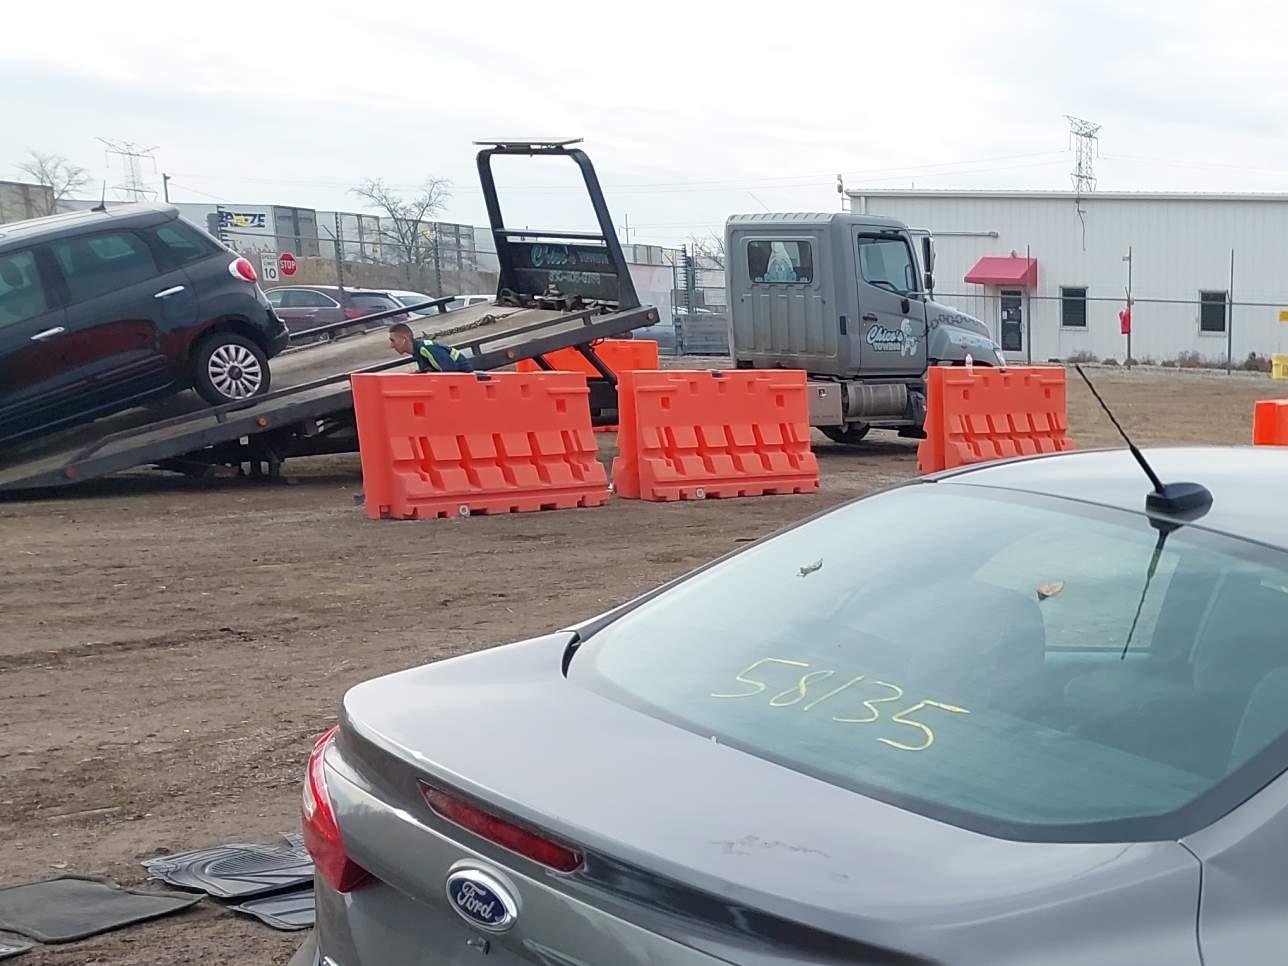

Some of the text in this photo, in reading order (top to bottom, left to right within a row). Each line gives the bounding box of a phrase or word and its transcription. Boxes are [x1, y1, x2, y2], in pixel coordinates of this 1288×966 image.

[264, 267, 276, 279] 10
[280, 260, 296, 270] STOP
[866, 325, 904, 344] Chico's
[710, 657, 971, 751] 58135
[457, 881, 495, 918] Ford
